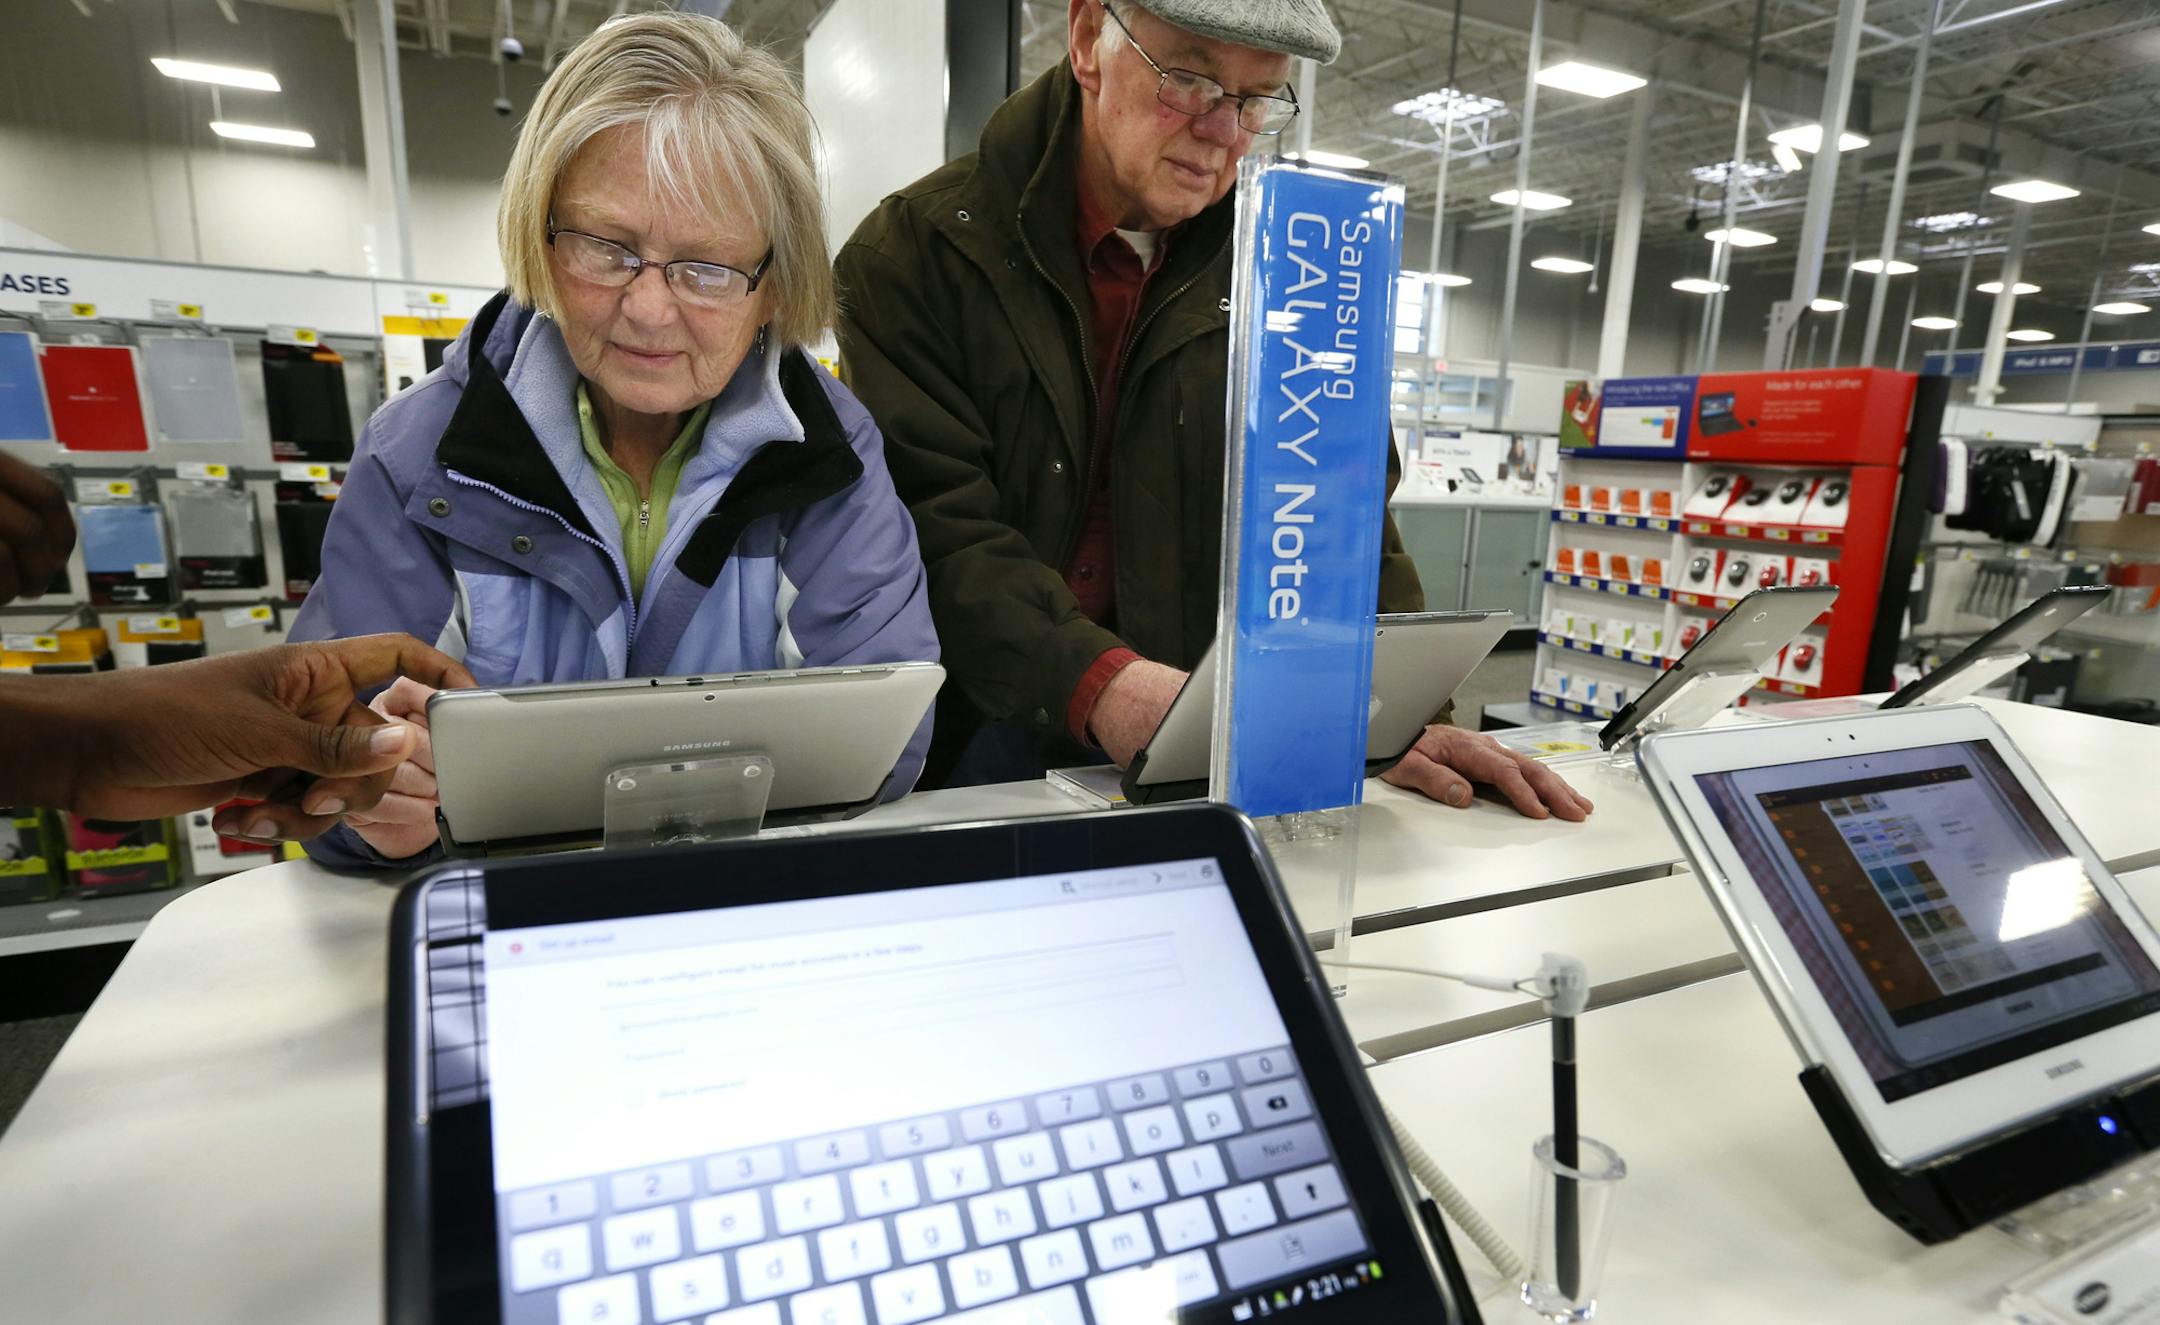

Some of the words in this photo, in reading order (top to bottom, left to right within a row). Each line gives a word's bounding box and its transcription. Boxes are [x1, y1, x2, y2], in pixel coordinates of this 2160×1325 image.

[0, 273, 70, 295] ASES
[1323, 219, 1371, 400] Samsung
[1275, 211, 1331, 466] GALAXY
[1765, 381, 1793, 391] Made
[1794, 380, 1807, 390] for
[1809, 379, 1832, 390] each
[1835, 378, 1862, 389] other
[1268, 483, 1316, 620] Note
[663, 740, 731, 751] SAMSUNG
[645, 1173, 661, 1197] 2
[737, 1157, 754, 1178] 3
[826, 1141, 841, 1159] 4
[908, 1126, 923, 1146] 5
[987, 1110, 1003, 1129] 6
[1060, 1095, 1073, 1114] 7
[1131, 1082, 1145, 1101] 8
[1196, 1069, 1211, 1087] 9
[1259, 1057, 1273, 1074] 0
[950, 1166, 964, 1187] y
[1018, 1152, 1034, 1168] u
[1147, 1125, 1162, 1140] o
[1206, 1111, 1221, 1130] p
[766, 1255, 784, 1281] d
[923, 1225, 941, 1249] g
[1127, 1174, 1144, 1194] k
[1261, 1140, 1295, 1155] Next
[975, 1266, 993, 1288] b
[1047, 1250, 1064, 1269] n
[1111, 1231, 1134, 1252] m
[1307, 1273, 1343, 1300] 2:21
